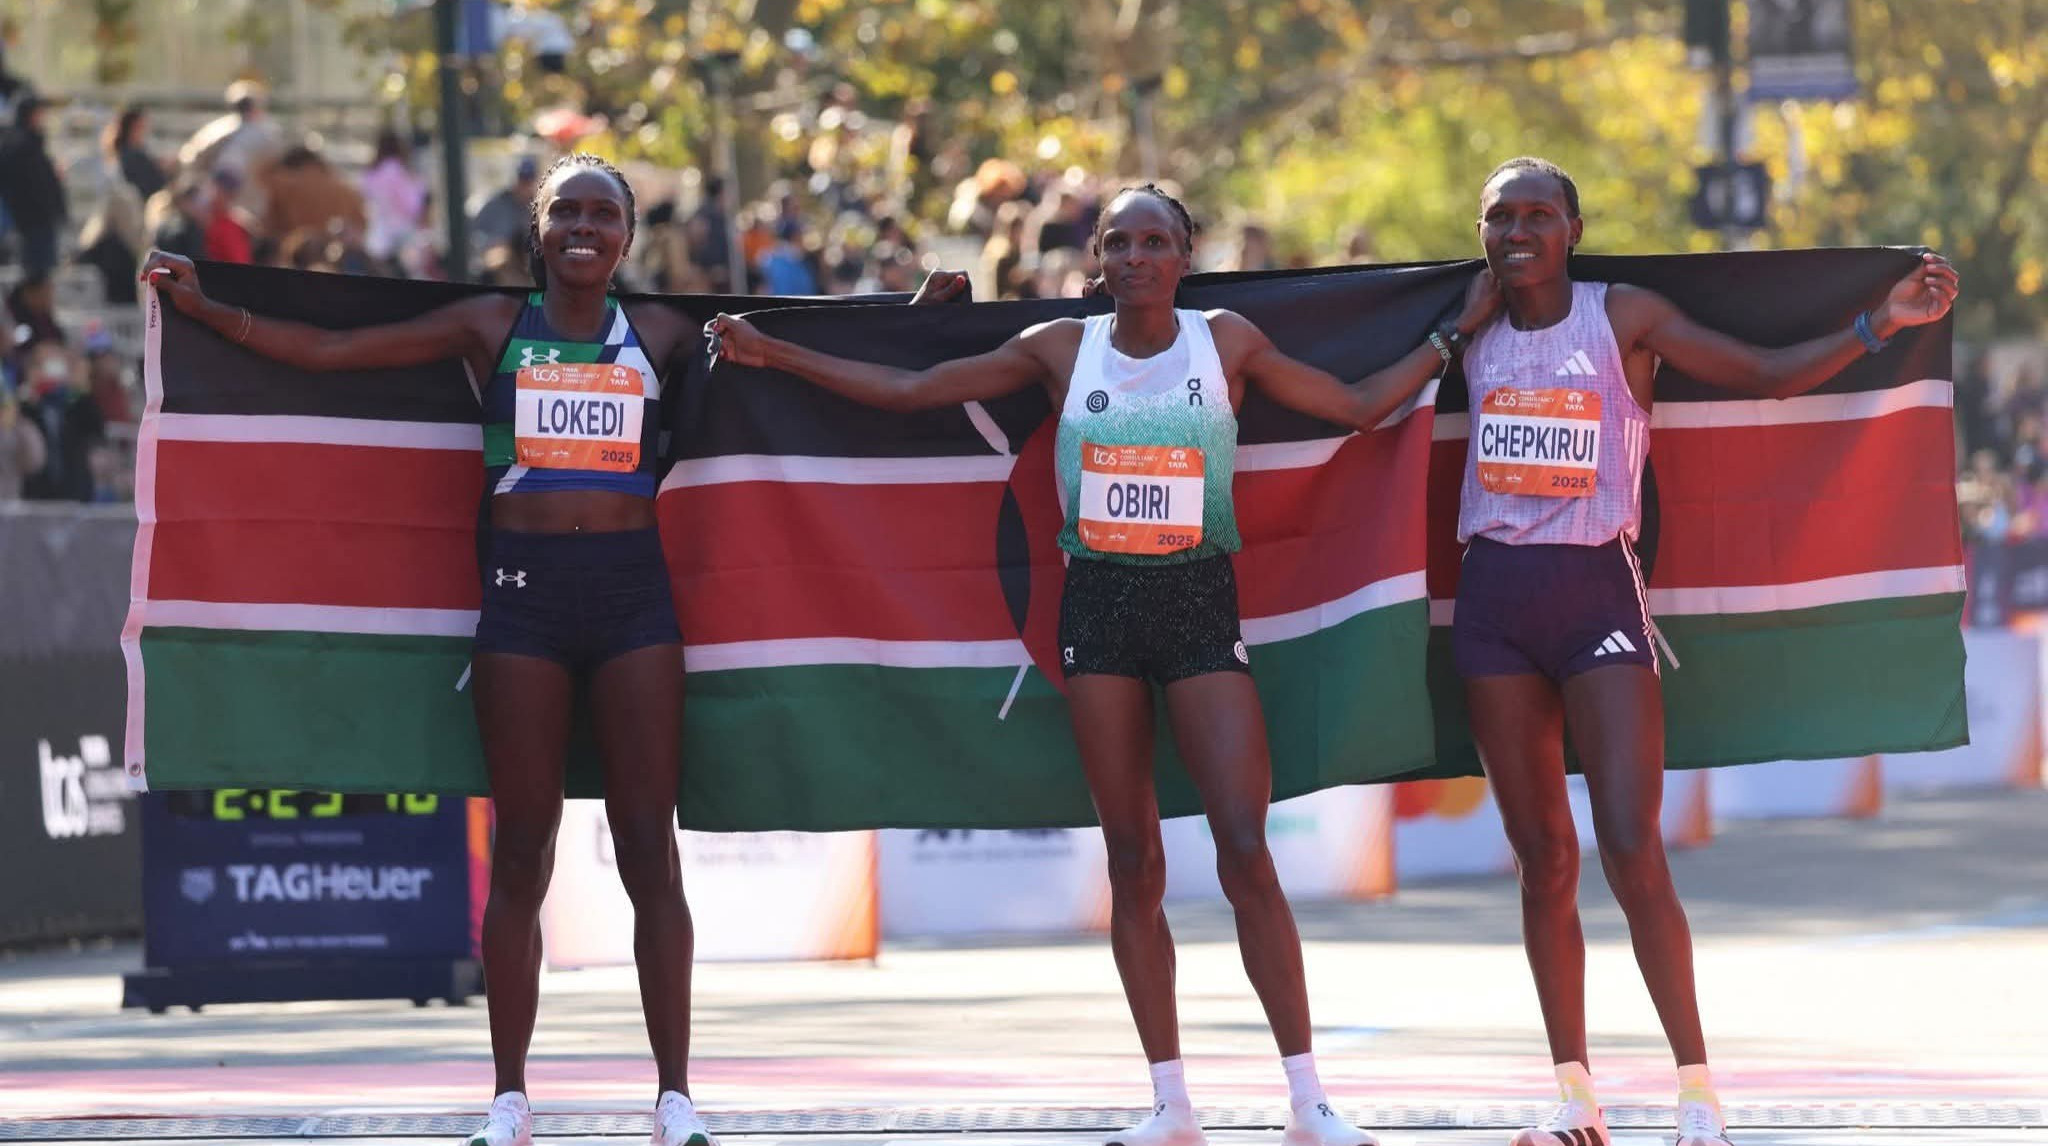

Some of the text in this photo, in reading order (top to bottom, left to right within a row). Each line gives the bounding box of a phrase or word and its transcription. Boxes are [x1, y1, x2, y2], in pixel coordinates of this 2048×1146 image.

[532, 367, 560, 382] tcs
[610, 379, 629, 387] TATA
[1494, 389, 1518, 407] tcs
[1564, 404, 1585, 412] TATA
[537, 398, 625, 437] LOKEDI
[1481, 422, 1595, 462] CHEPKIRUI
[601, 450, 633, 463] 2025
[1093, 446, 1118, 466] tcs
[1551, 475, 1588, 489] 2025
[1107, 482, 1170, 520] OBIRI
[1157, 533, 1195, 547] 2025
